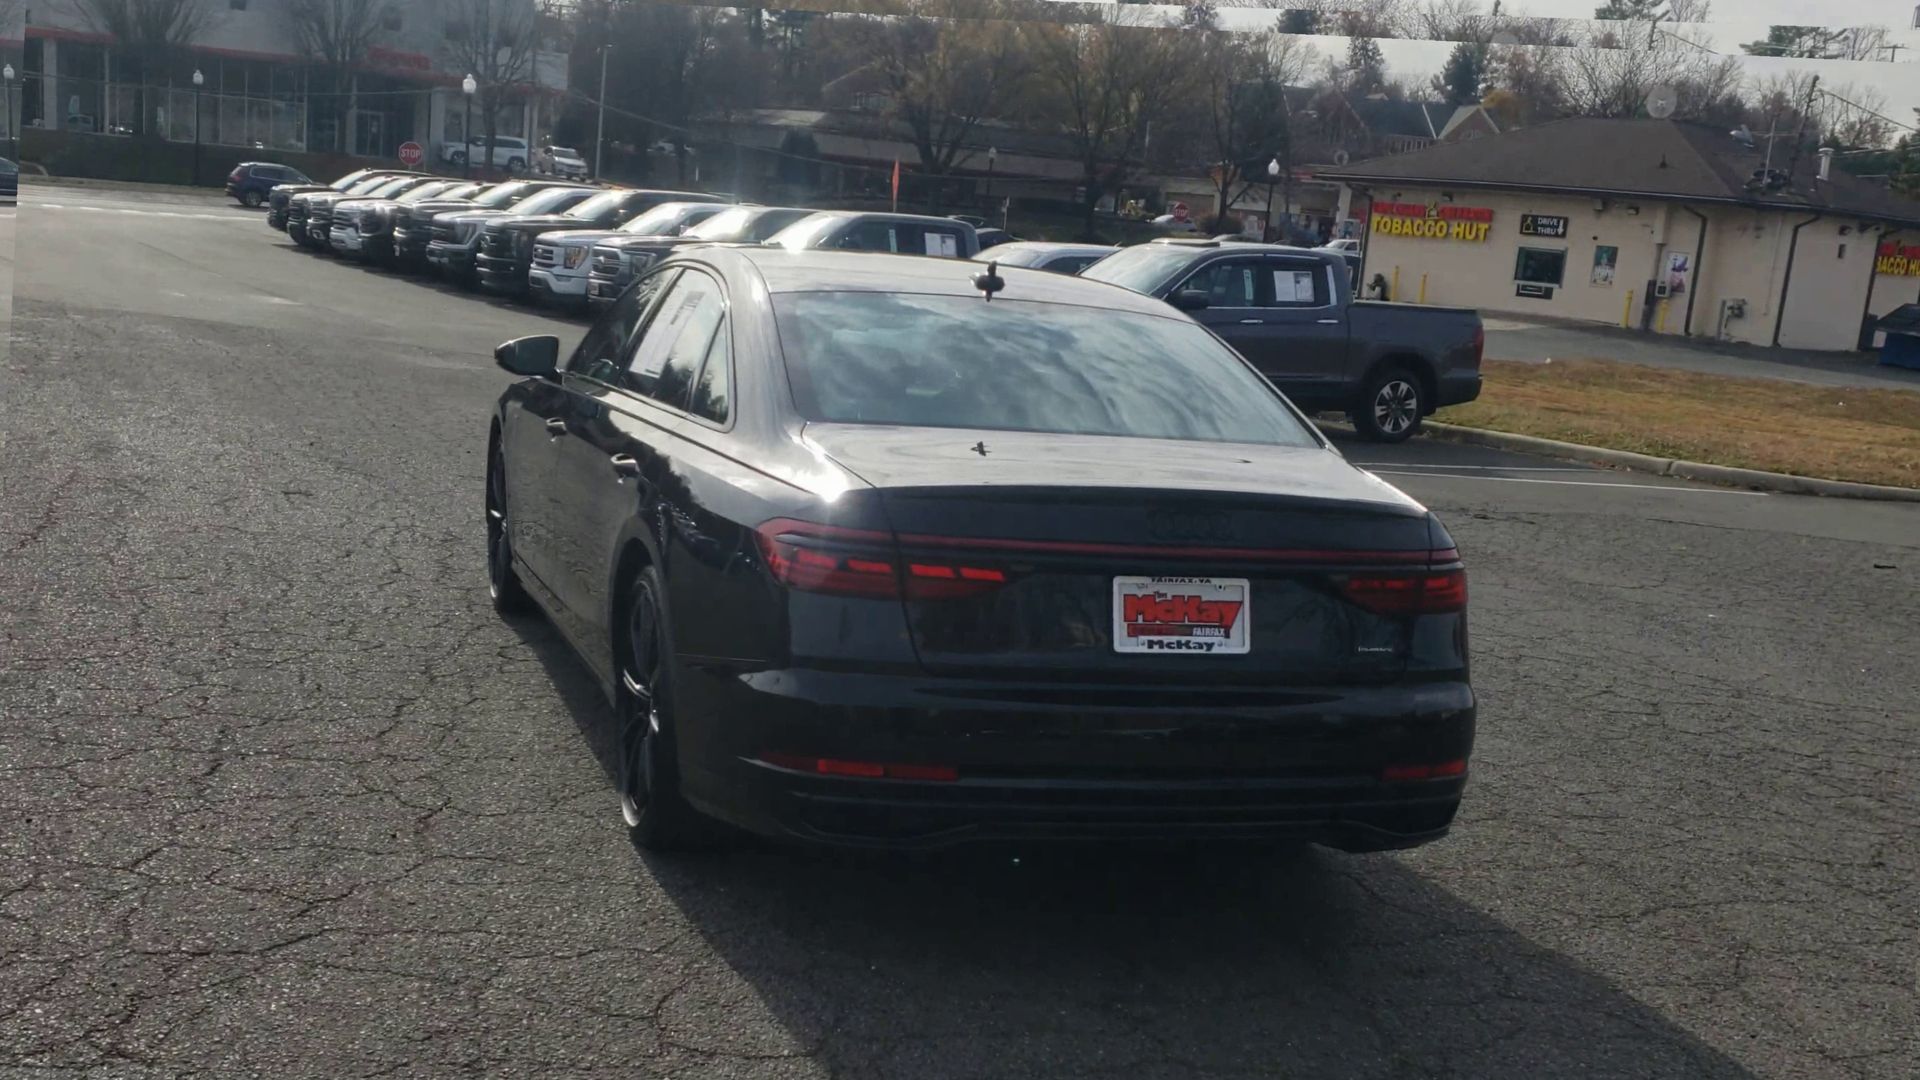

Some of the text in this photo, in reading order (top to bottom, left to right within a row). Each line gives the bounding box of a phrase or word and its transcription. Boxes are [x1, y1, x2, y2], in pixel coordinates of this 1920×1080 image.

[400, 148, 421, 159] STOP
[1537, 217, 1558, 226] DRIVE
[1372, 215, 1448, 237] TOBACCO
[1452, 221, 1489, 241] HUT
[1537, 226, 1556, 235] THRU
[1124, 594, 1242, 629] McKay
[1192, 627, 1225, 637] FAIRFAX
[1147, 640, 1216, 652] McKay
